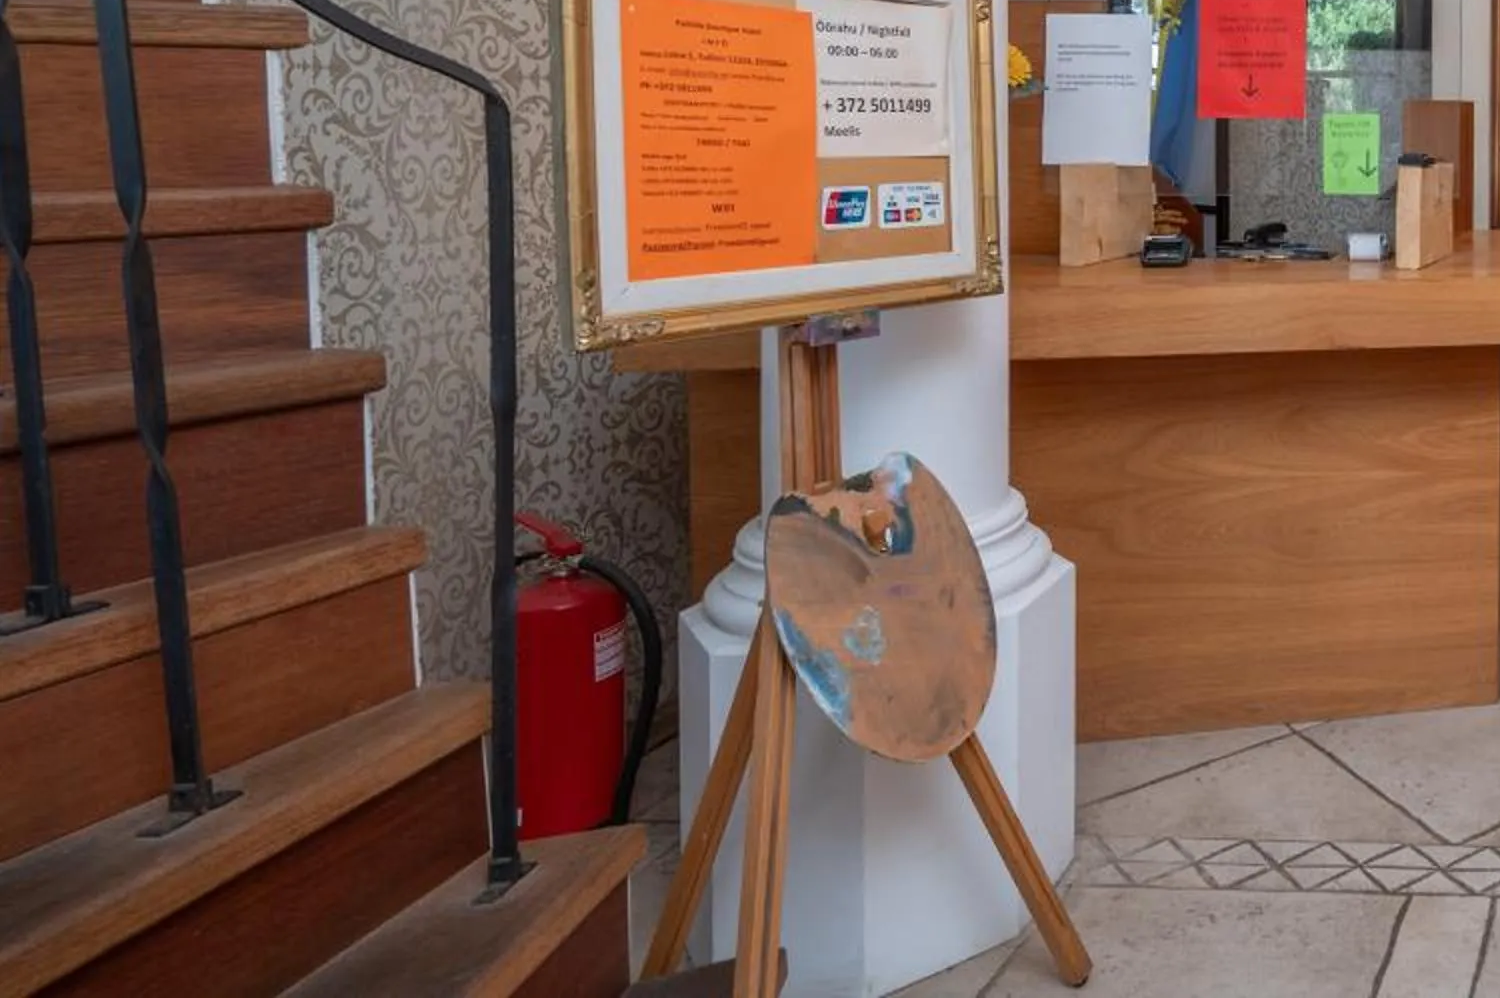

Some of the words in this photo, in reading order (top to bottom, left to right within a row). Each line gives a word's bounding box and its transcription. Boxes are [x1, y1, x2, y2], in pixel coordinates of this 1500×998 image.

[816, 20, 857, 34] Öörahu
[867, 25, 911, 38] Nightfall
[827, 45, 859, 57] 00:00
[837, 97, 866, 113] 372
[870, 98, 931, 113] 5011499
[824, 125, 861, 137] Meelis
